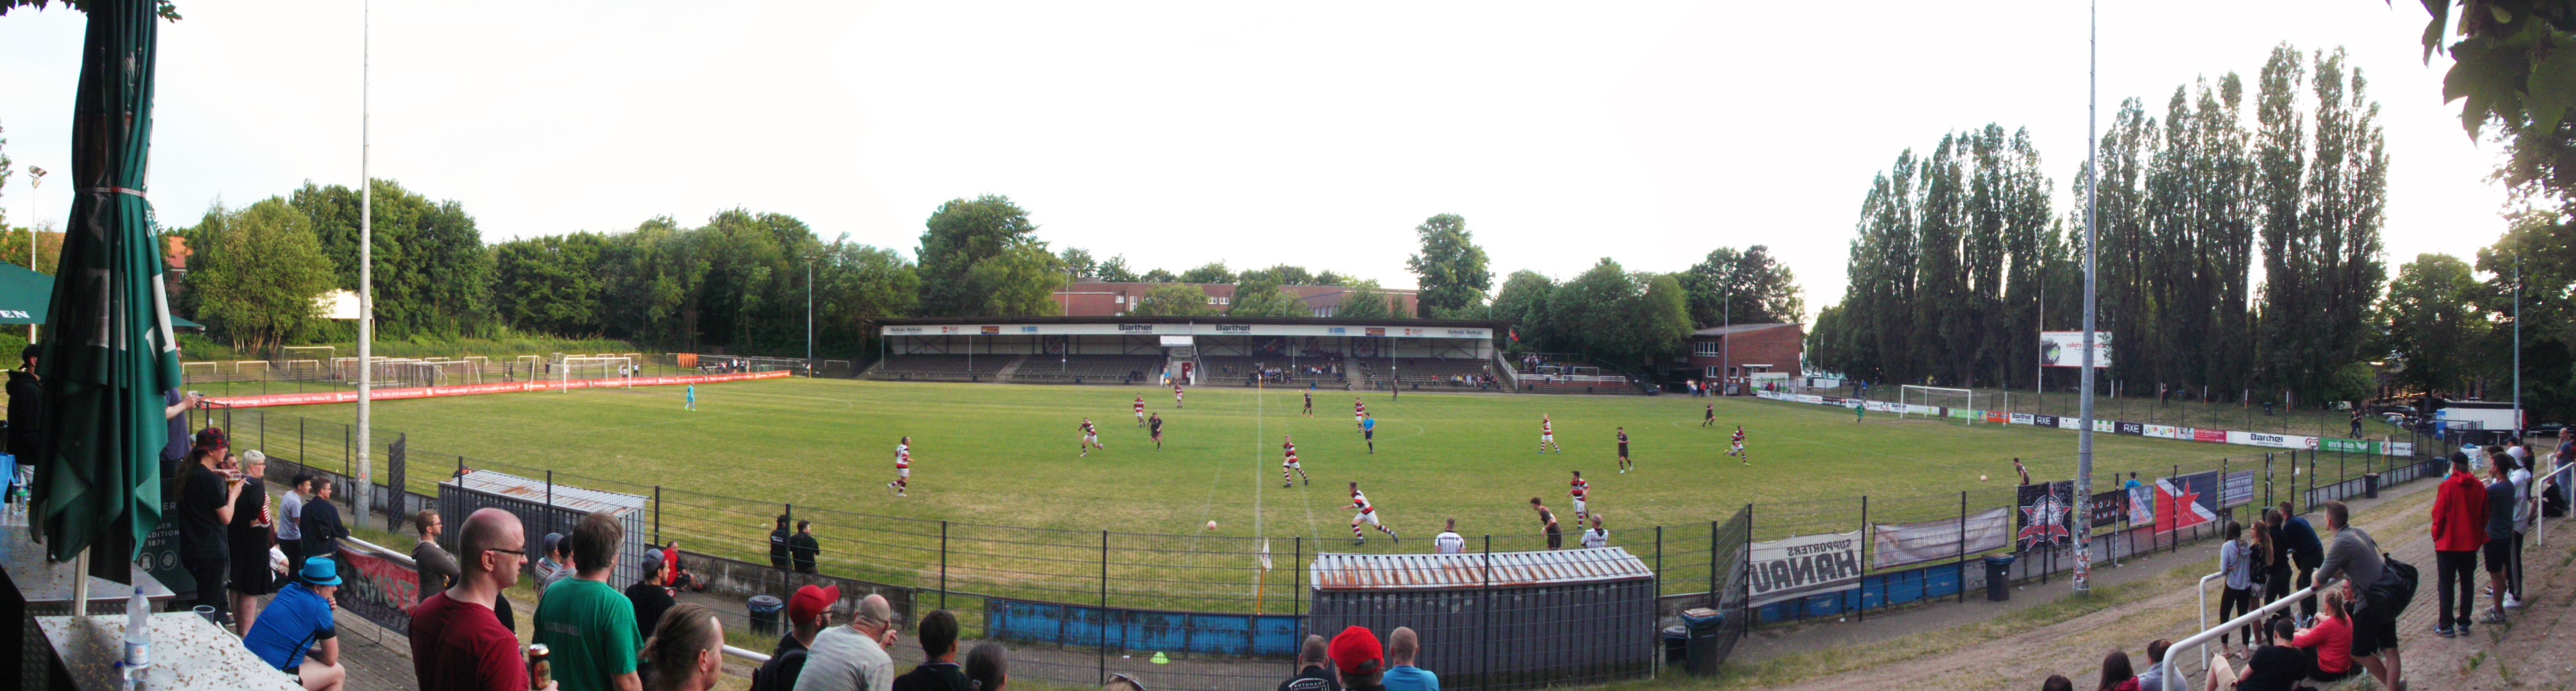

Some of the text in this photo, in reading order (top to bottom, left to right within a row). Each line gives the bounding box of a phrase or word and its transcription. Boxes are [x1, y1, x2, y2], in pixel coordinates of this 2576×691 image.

[2037, 416, 2051, 425] AXE
[2124, 423, 2140, 433] AXE
[2250, 433, 2283, 443] Barthel
